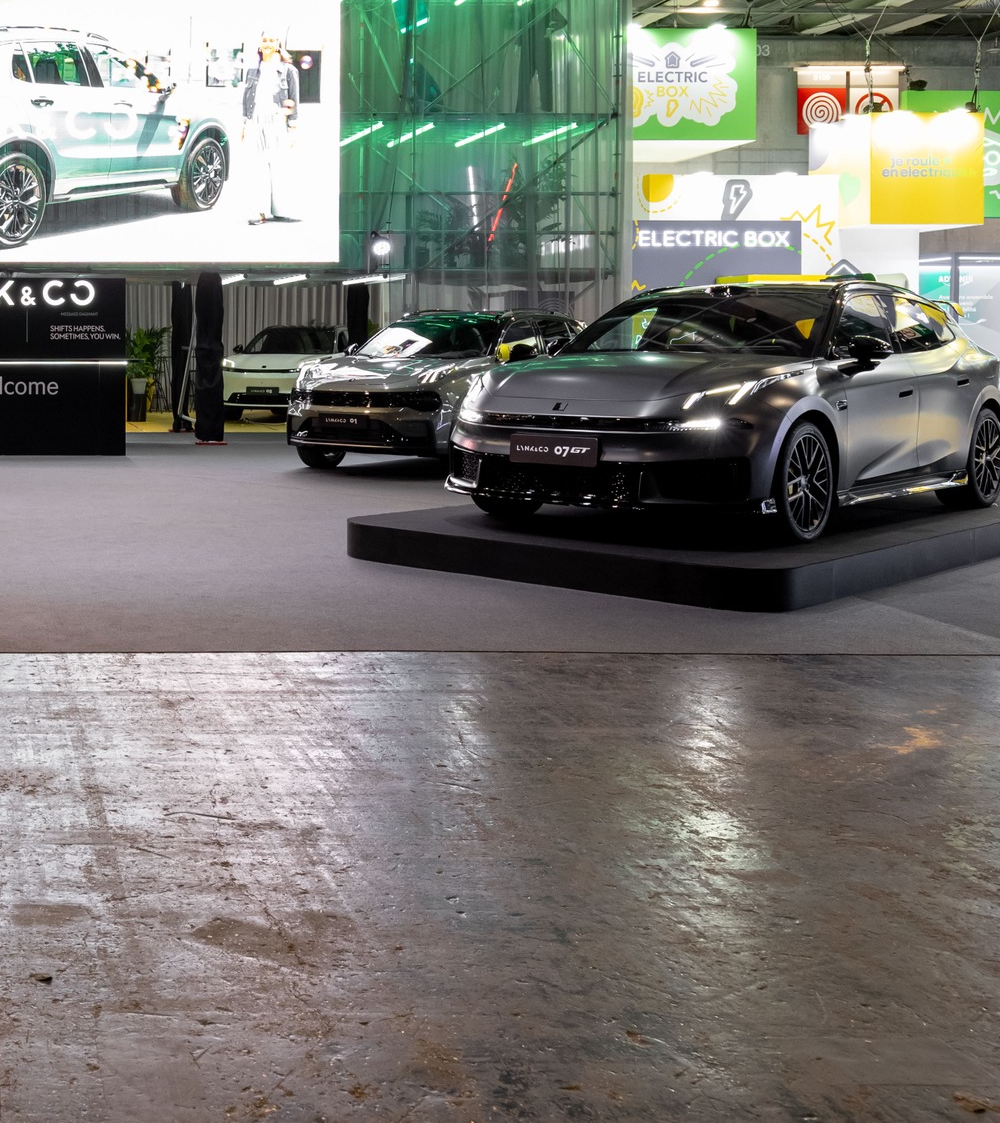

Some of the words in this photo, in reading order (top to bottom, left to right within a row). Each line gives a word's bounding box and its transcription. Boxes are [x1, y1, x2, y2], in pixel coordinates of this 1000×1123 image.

[637, 71, 708, 83] ELECTRIC
[656, 85, 689, 98] BOX
[881, 168, 899, 178] en
[638, 230, 739, 247] ELECTRIC
[743, 230, 790, 248] BOX
[516, 444, 549, 453] LYNK&CO
